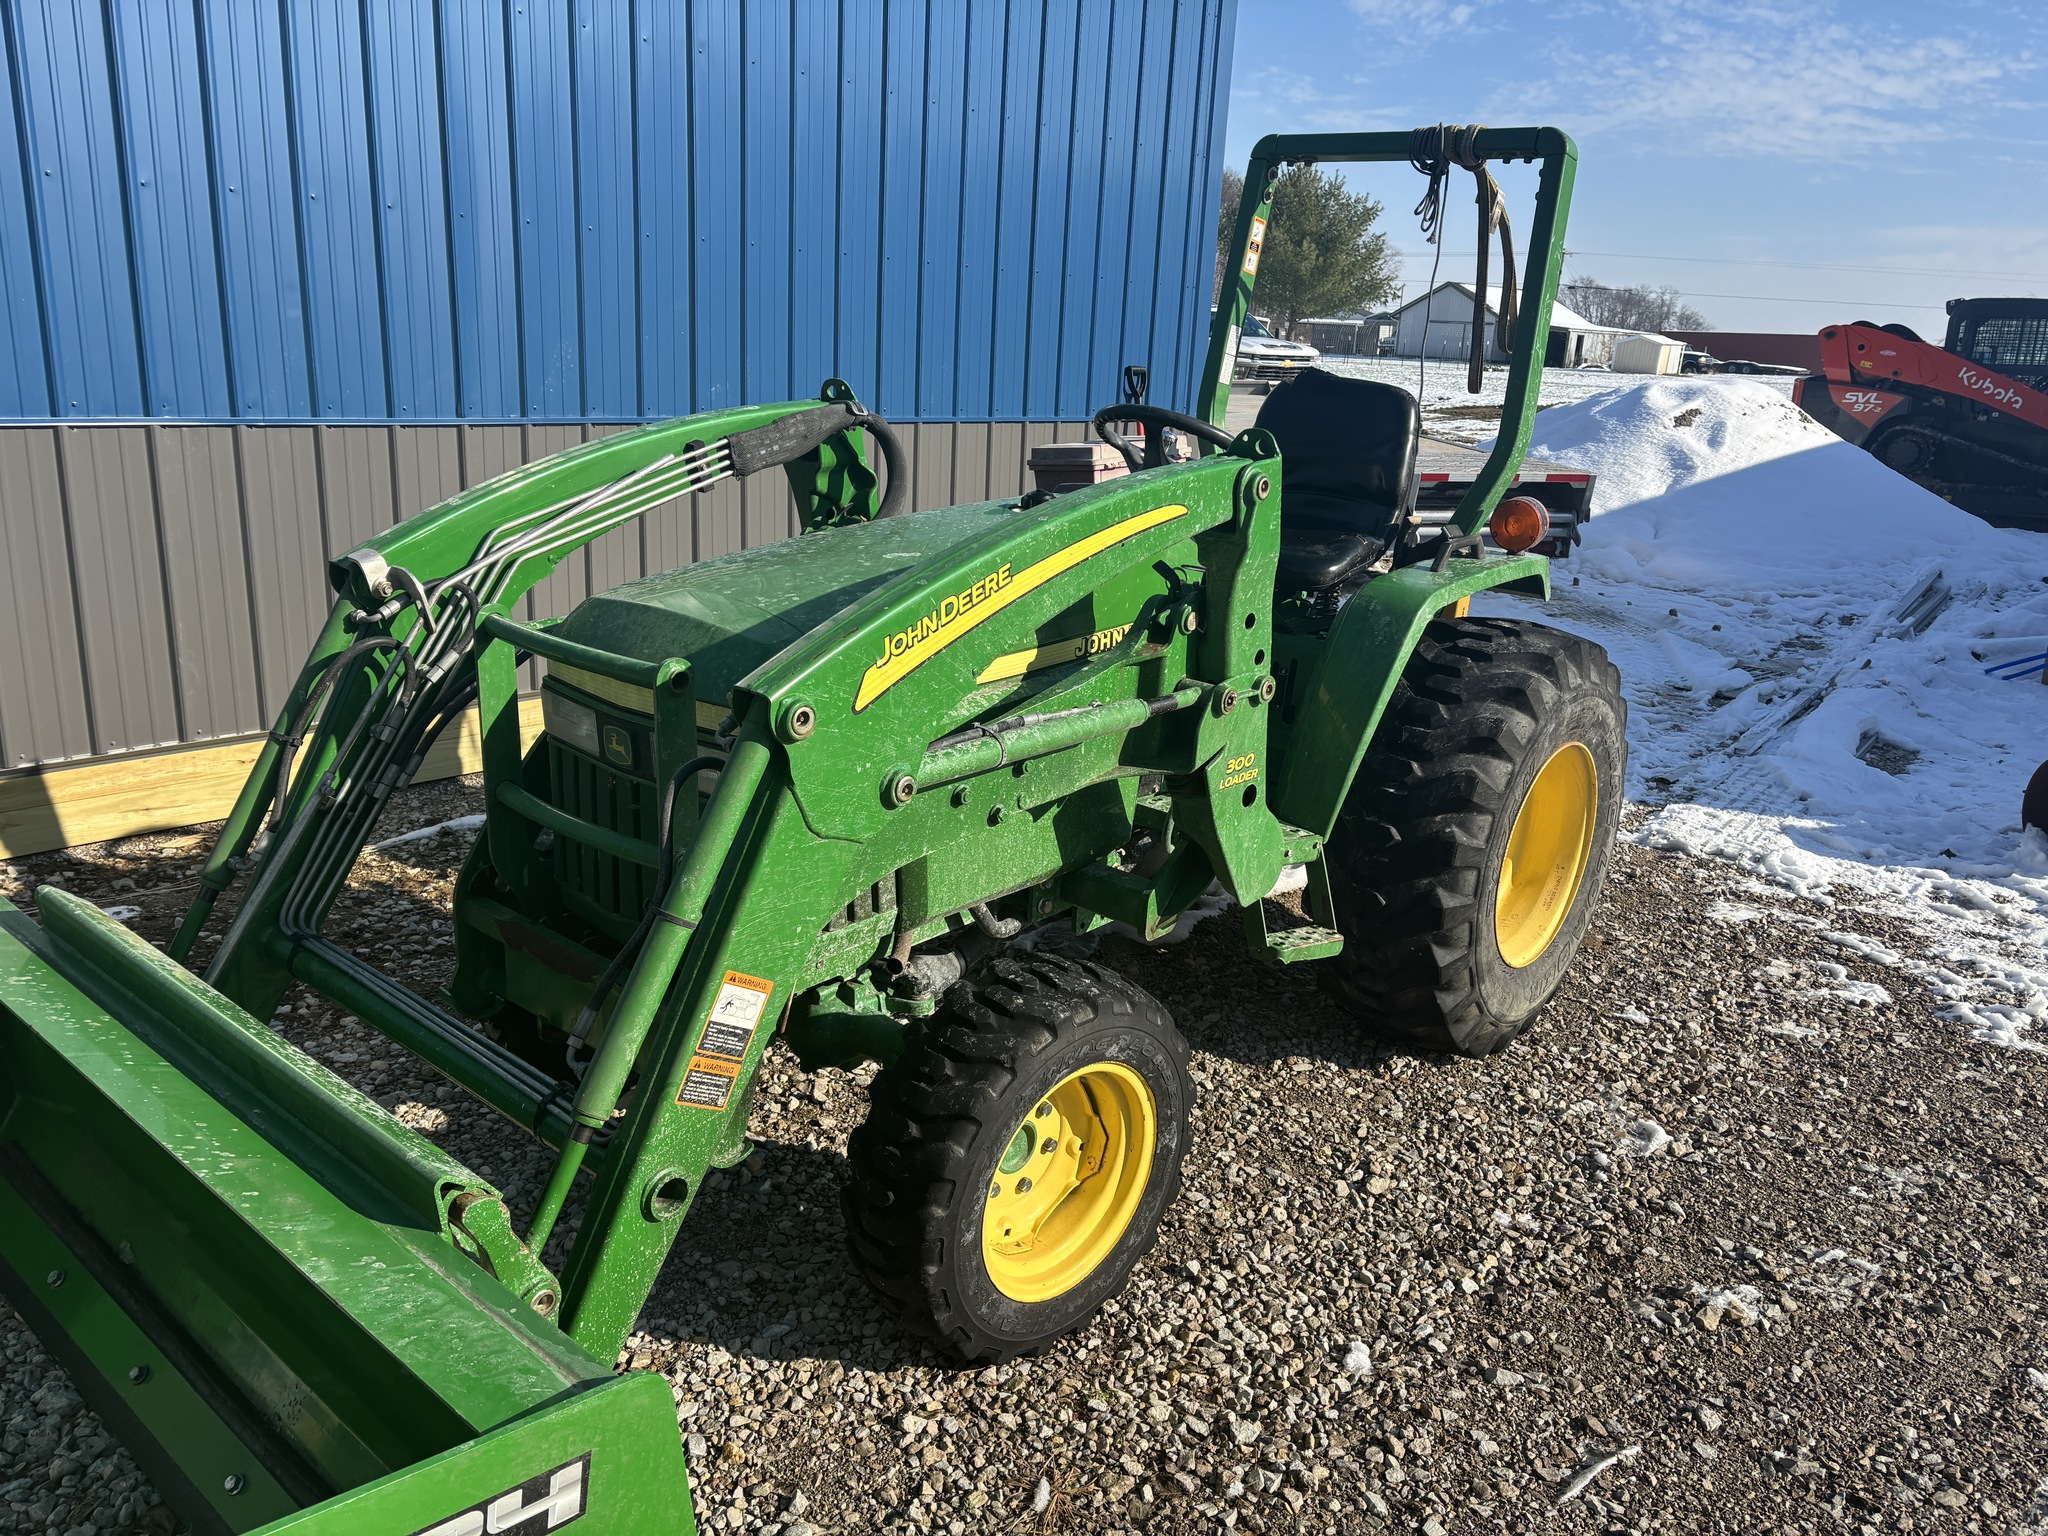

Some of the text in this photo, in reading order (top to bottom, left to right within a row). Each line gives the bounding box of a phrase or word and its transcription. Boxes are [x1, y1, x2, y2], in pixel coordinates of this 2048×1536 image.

[1842, 392, 1883, 404] SVL
[1957, 367, 2024, 409] Kubota
[1852, 403, 1882, 413] 97-2
[876, 561, 1012, 669] JOHN DEERE
[1075, 627, 1125, 657] JOHN
[1226, 752, 1255, 775] 300
[1219, 768, 1259, 791] LOADER
[737, 976, 767, 990] WARNING
[703, 1061, 735, 1075] WARNING
